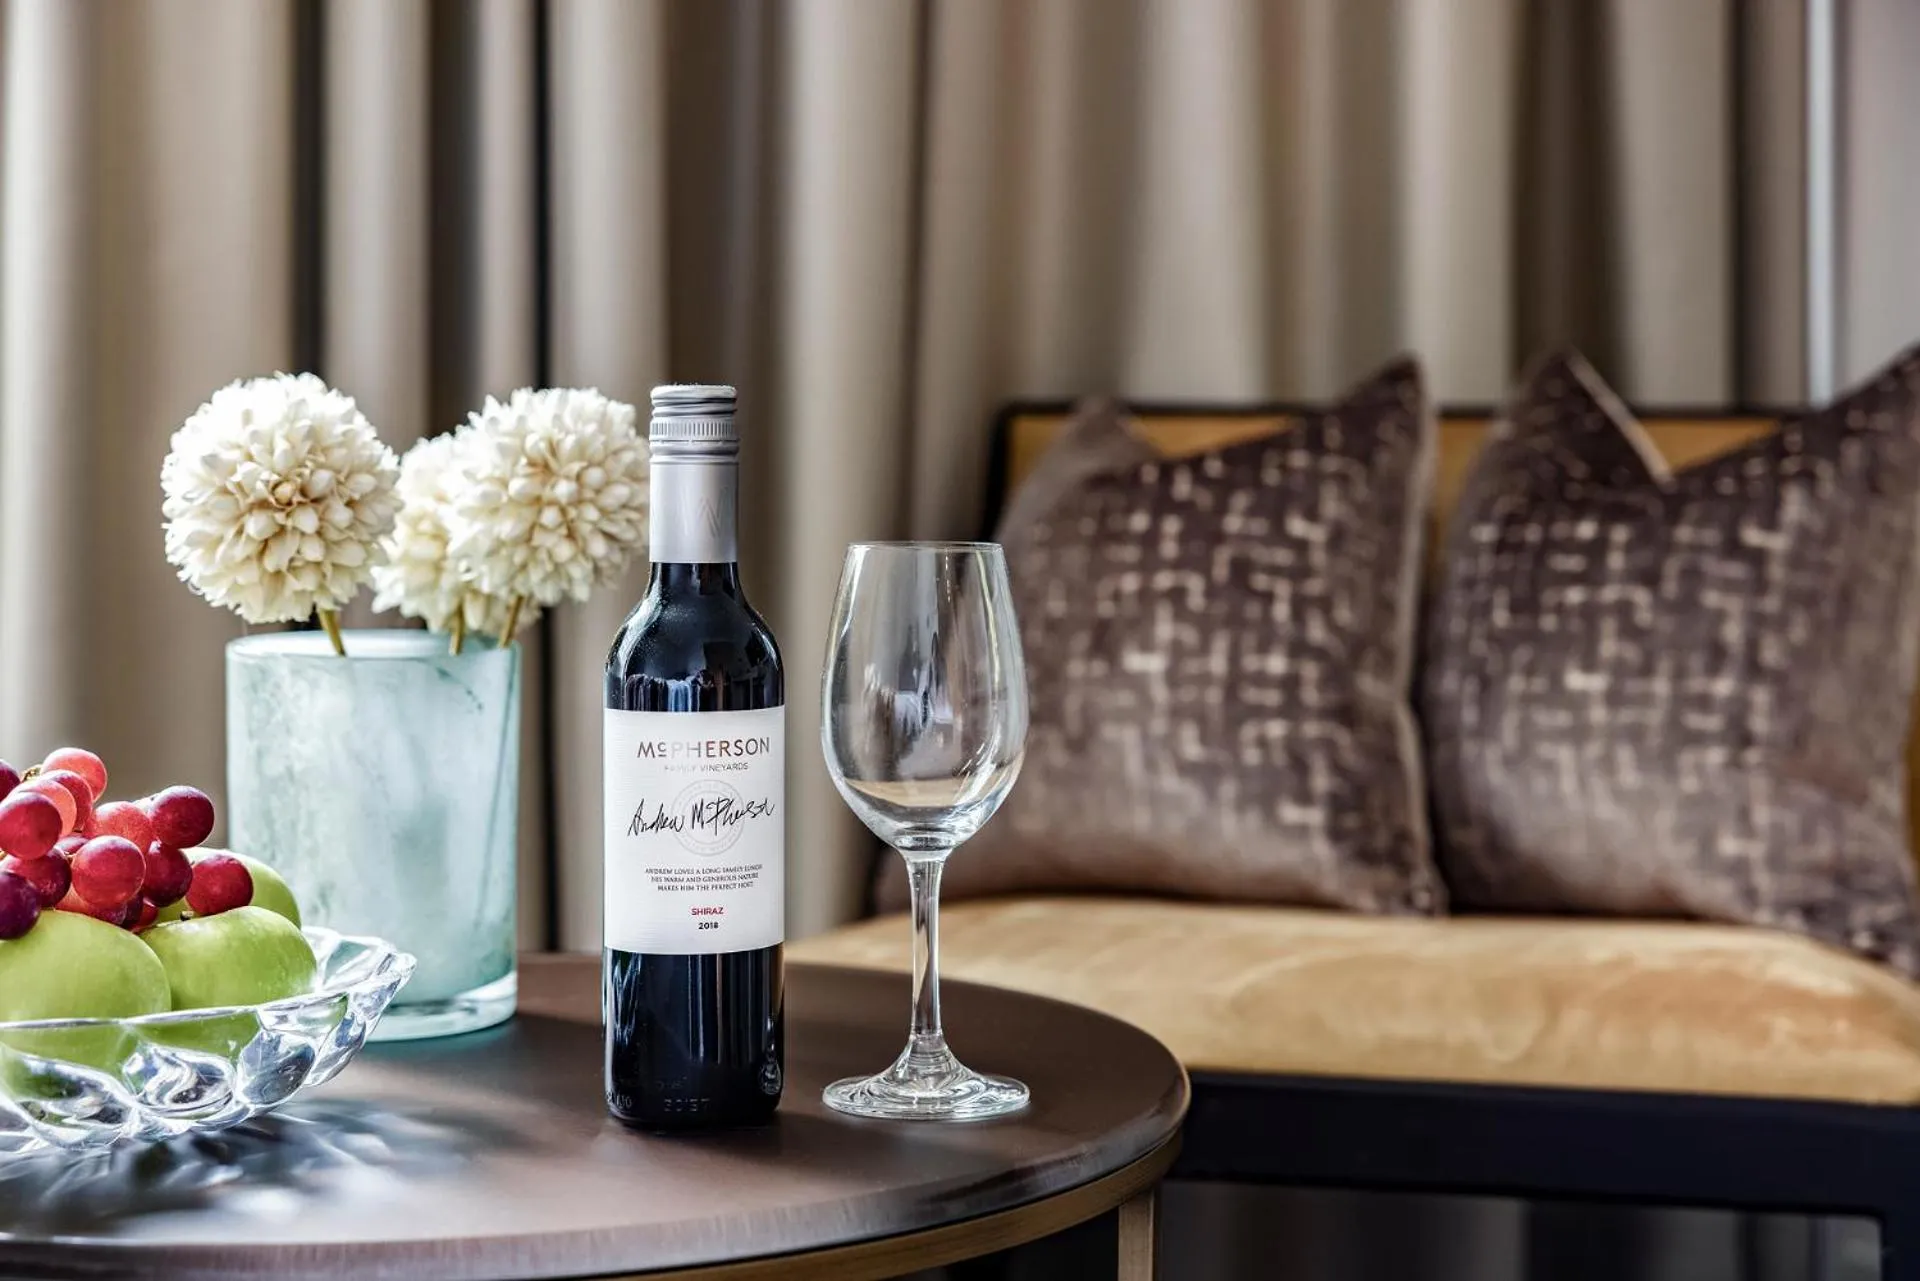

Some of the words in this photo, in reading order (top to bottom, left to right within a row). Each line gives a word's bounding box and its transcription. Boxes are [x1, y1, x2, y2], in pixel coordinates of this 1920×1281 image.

[699, 761, 750, 773] VINEYARDS
[674, 867, 695, 875] LOVES
[702, 866, 721, 875] LONG
[685, 875, 701, 883] AND
[711, 882, 737, 890] PERFECT
[691, 906, 725, 916] SHIRAZ
[698, 921, 720, 930] 2018
